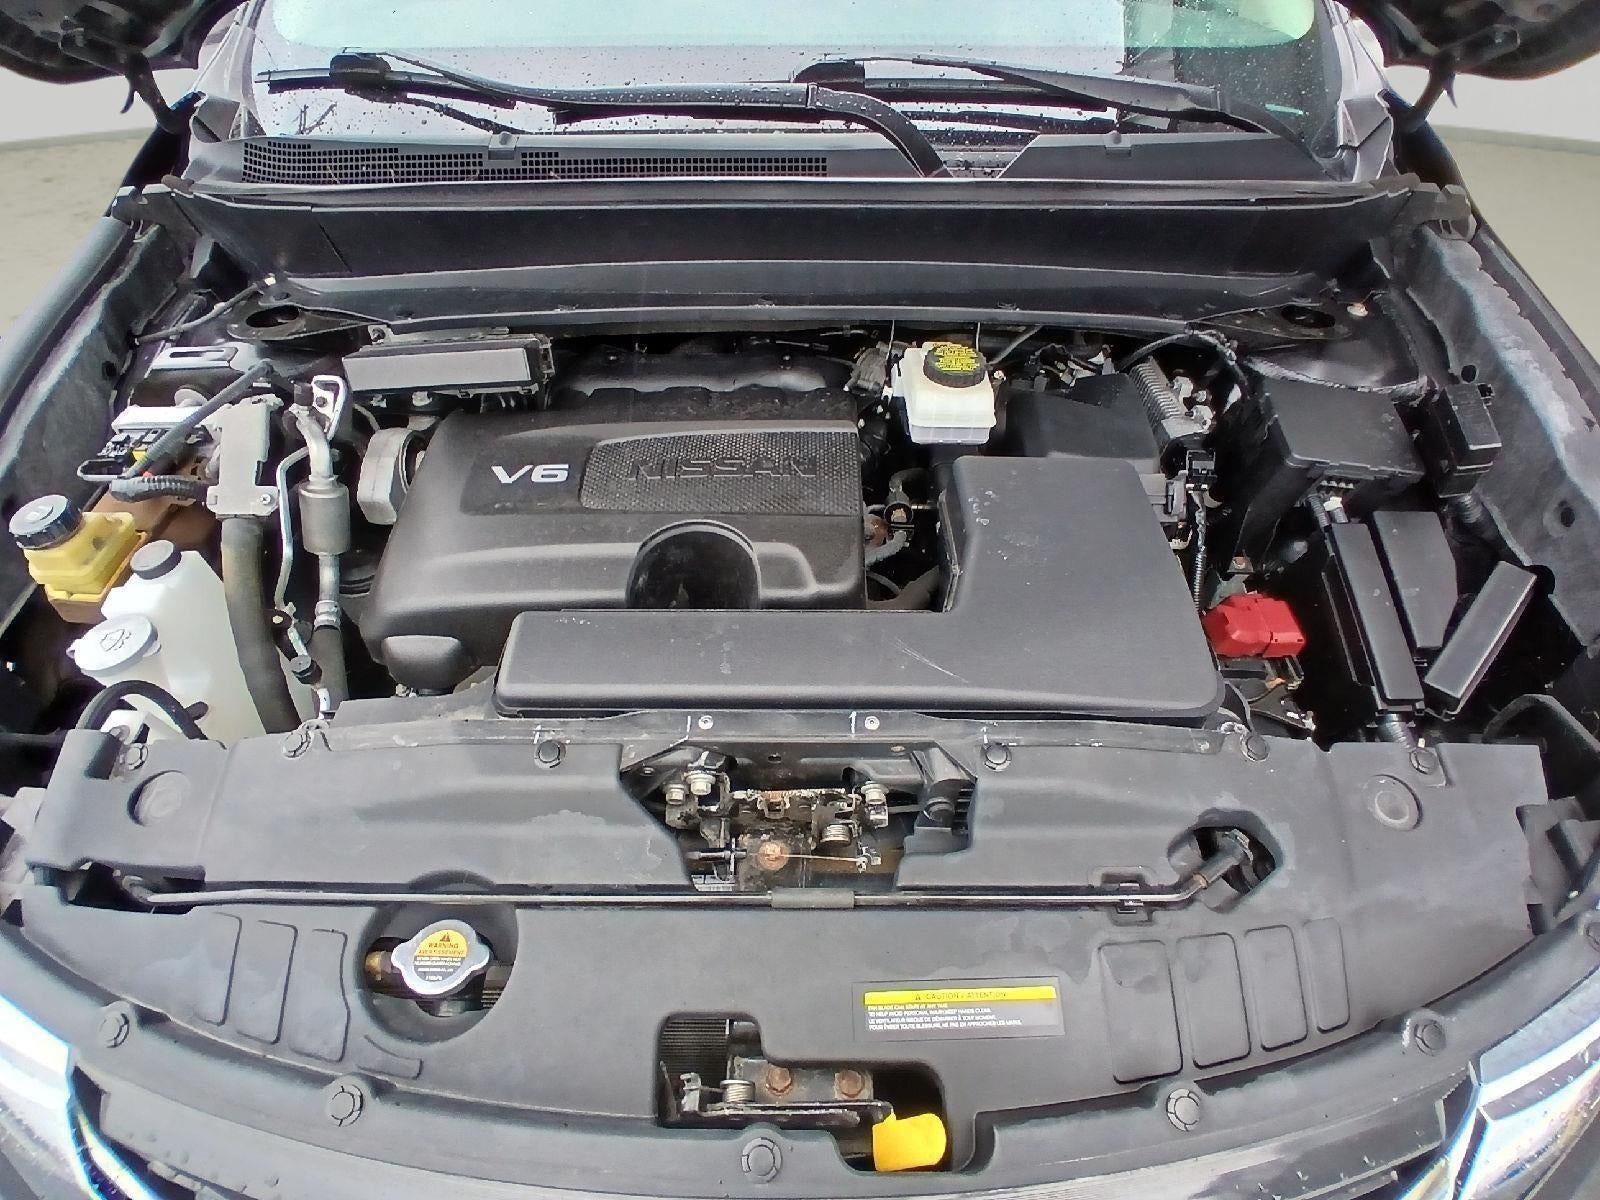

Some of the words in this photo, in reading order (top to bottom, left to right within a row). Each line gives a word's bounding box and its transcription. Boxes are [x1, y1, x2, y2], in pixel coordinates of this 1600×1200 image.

[490, 463, 569, 484] V6
[628, 457, 817, 480] NISSAN
[925, 991, 959, 1000] CAUTION
